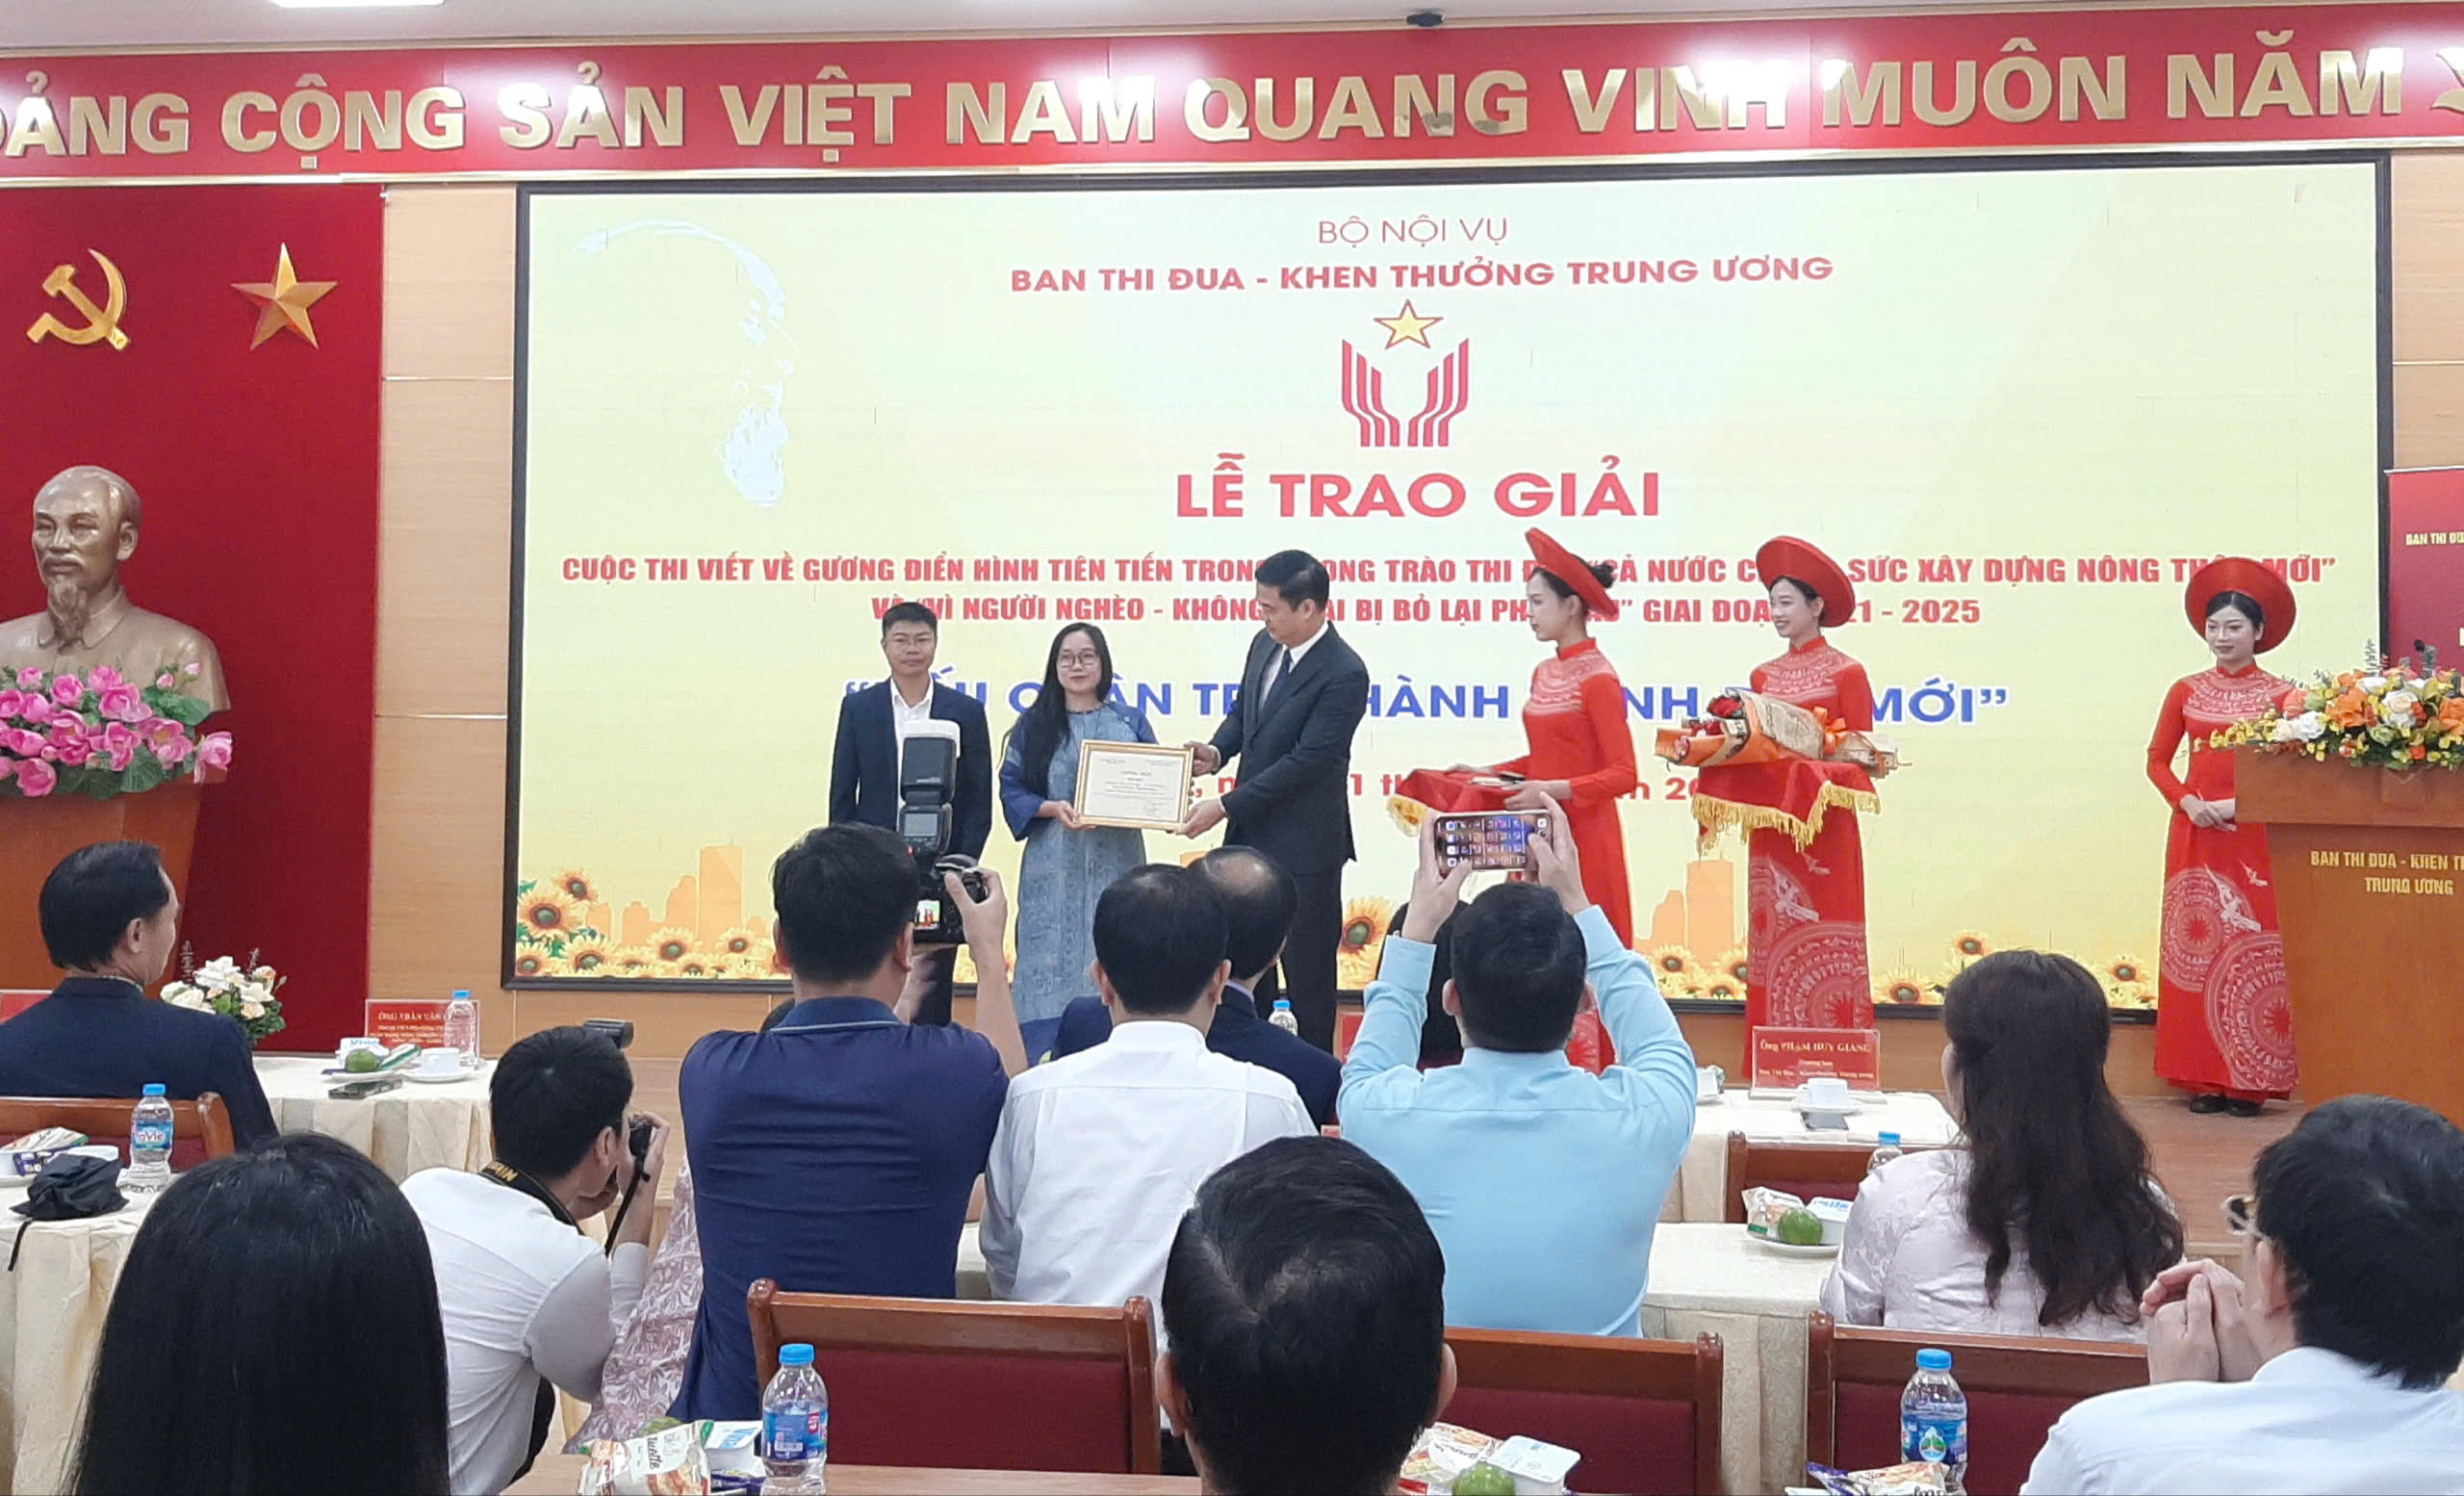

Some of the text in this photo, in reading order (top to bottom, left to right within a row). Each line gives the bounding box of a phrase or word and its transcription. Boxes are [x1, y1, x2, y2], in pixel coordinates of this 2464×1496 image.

[0, 29, 2404, 169] ẢNG CỘNG SẢN VIỆT NAM QUANG VINH MUÔN NĂM
[1319, 214, 1507, 248] BỘ NỘI VỤ
[1012, 269, 1086, 292] BAN
[1099, 269, 1154, 291] THI
[1168, 268, 1245, 291] ĐUA
[1280, 266, 1377, 289] KHEN
[1390, 255, 1555, 288] THƯỞNG
[1567, 259, 1699, 285] TRUNG
[1713, 254, 1834, 282] ƯƠNG
[1177, 451, 1660, 518] LỄ TRAO GIẢI
[2405, 532, 2428, 546] BAN
[2430, 532, 2447, 545] THI
[562, 554, 636, 585] CUỘC
[644, 557, 688, 581] THI
[698, 550, 756, 581] VIẾT
[762, 550, 795, 581] VỀ
[803, 555, 894, 581] GƯƠNG
[904, 550, 964, 582] ĐIỂN
[973, 555, 1040, 582] HÌNH
[1047, 555, 1106, 582] TIÊN
[1115, 551, 1173, 582] TIẾN
[1182, 558, 1267, 582] TRON
[1322, 558, 1376, 582] ONG
[1384, 555, 1456, 582] TRÀO
[1466, 558, 1513, 582] THI
[1648, 554, 1727, 582] NƯỚC
[1847, 555, 1908, 582] SỨC
[1917, 555, 1973, 582] XÂY
[1985, 555, 2066, 587] DỰNG
[2077, 555, 2160, 582] NÔNG
[962, 594, 1046, 620] NGƯỜI
[1057, 594, 1145, 621] NGHÈO
[1172, 594, 1263, 621] KHÔNG
[1355, 598, 1383, 627] BỊ
[1393, 593, 1430, 622] BỎ
[1440, 598, 1481, 627] LẠI
[1492, 599, 1528, 622] PH
[1643, 599, 1702, 623] GIAI
[1712, 599, 1772, 628] ĐOẠ
[1902, 599, 1981, 624] 2025
[1366, 674, 1509, 718] HÀNH
[2310, 850, 2340, 866] BAN
[2343, 852, 2365, 867] THI
[2368, 852, 2397, 868] ĐUA
[2410, 854, 2450, 870] KHEN
[2364, 877, 2454, 895] TRUNG ƯƠNG
[1836, 1043, 1872, 1053] GIANG
